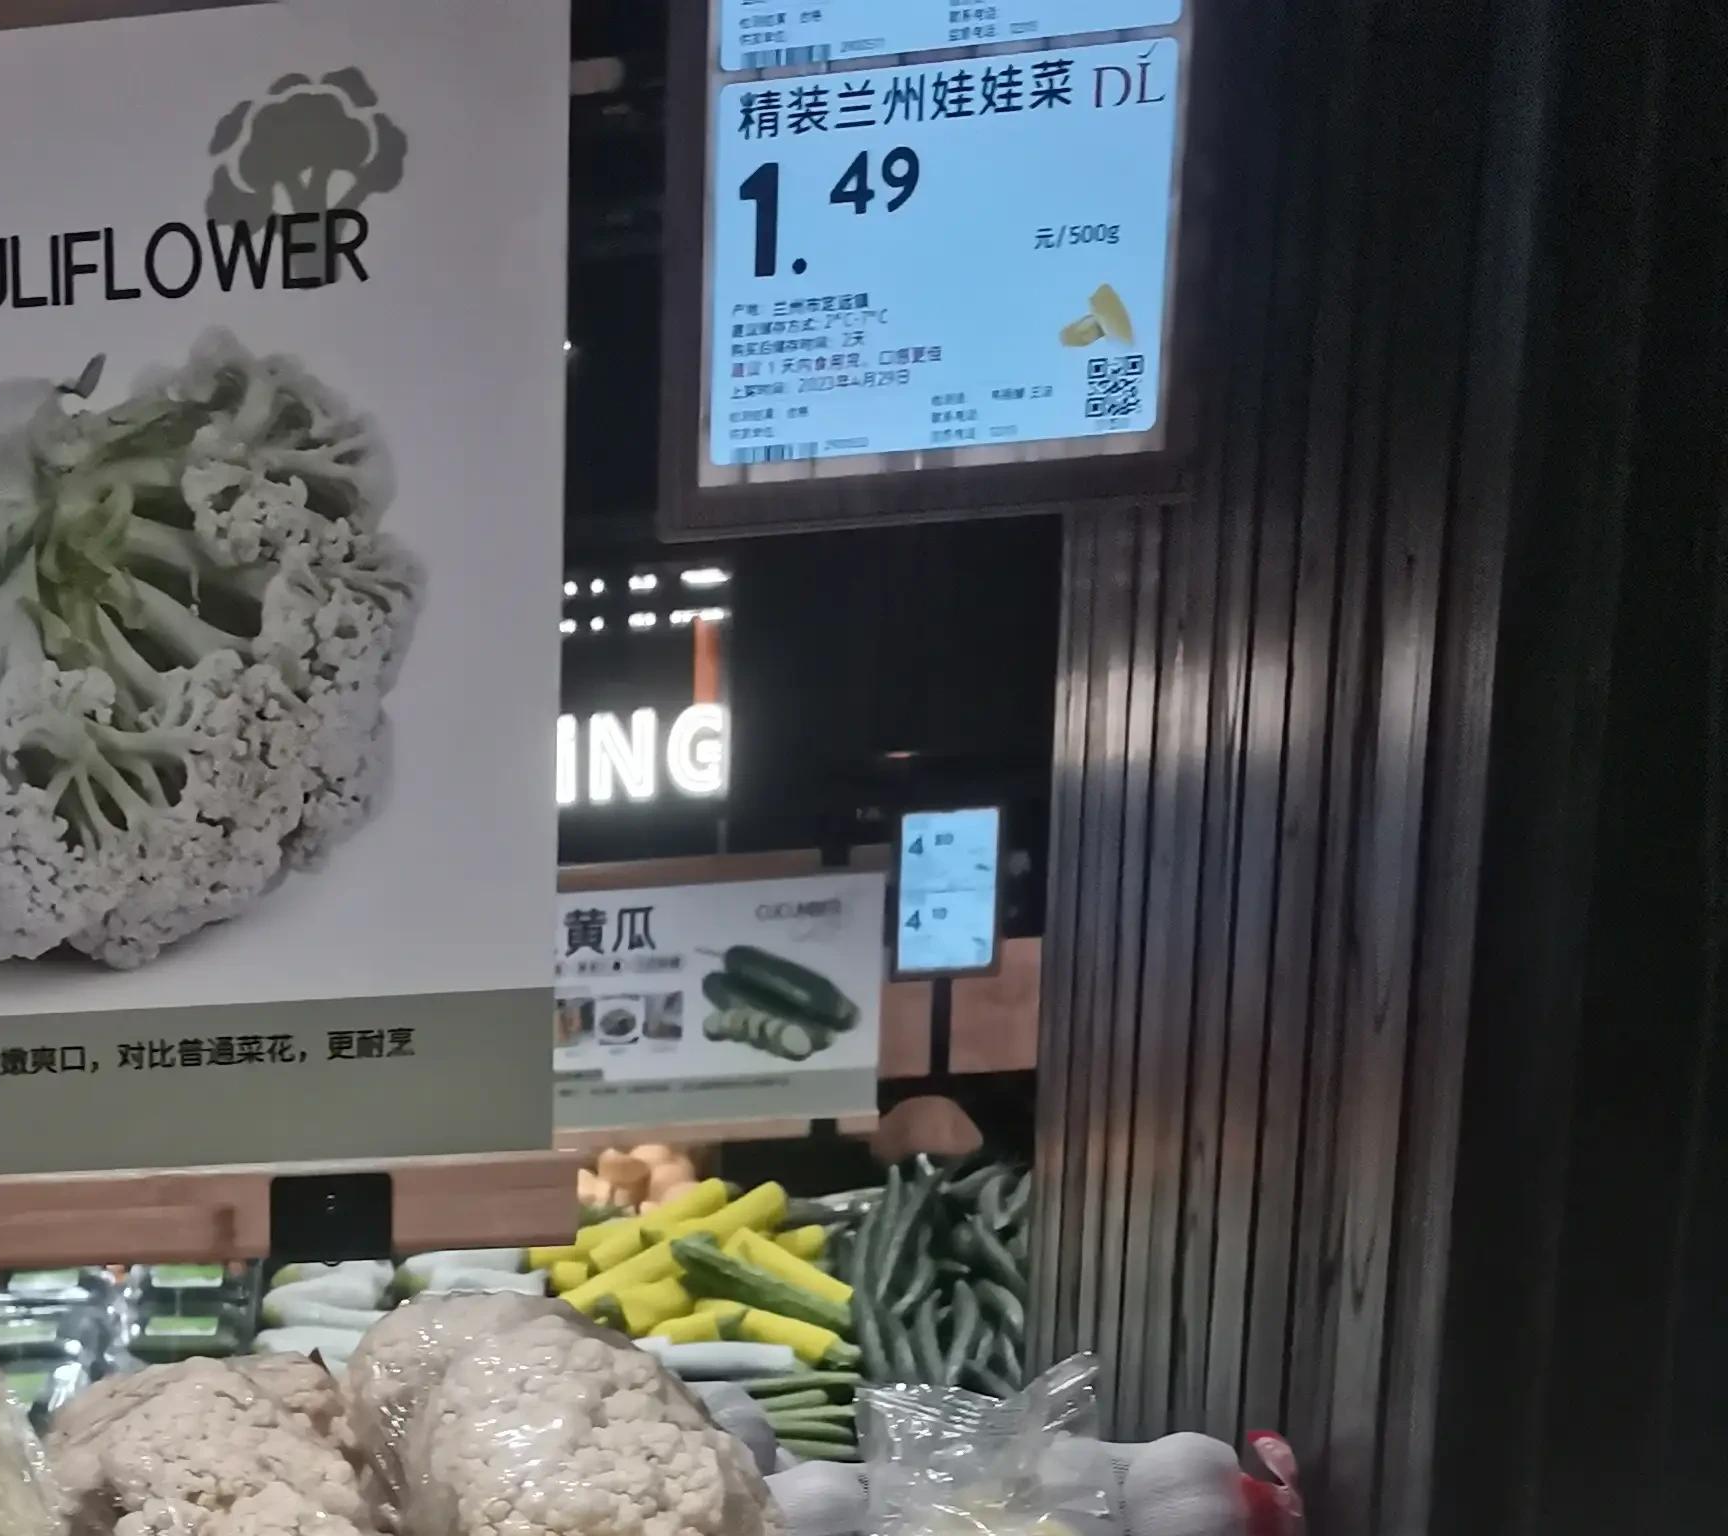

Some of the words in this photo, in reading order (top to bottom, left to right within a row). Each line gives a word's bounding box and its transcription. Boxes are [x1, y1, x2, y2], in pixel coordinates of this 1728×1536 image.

[737, 60, 1075, 140] 精装兰州娃娃菜
[1034, 223, 1121, 250] 元/500g
[564, 905, 657, 957] 黄瓜
